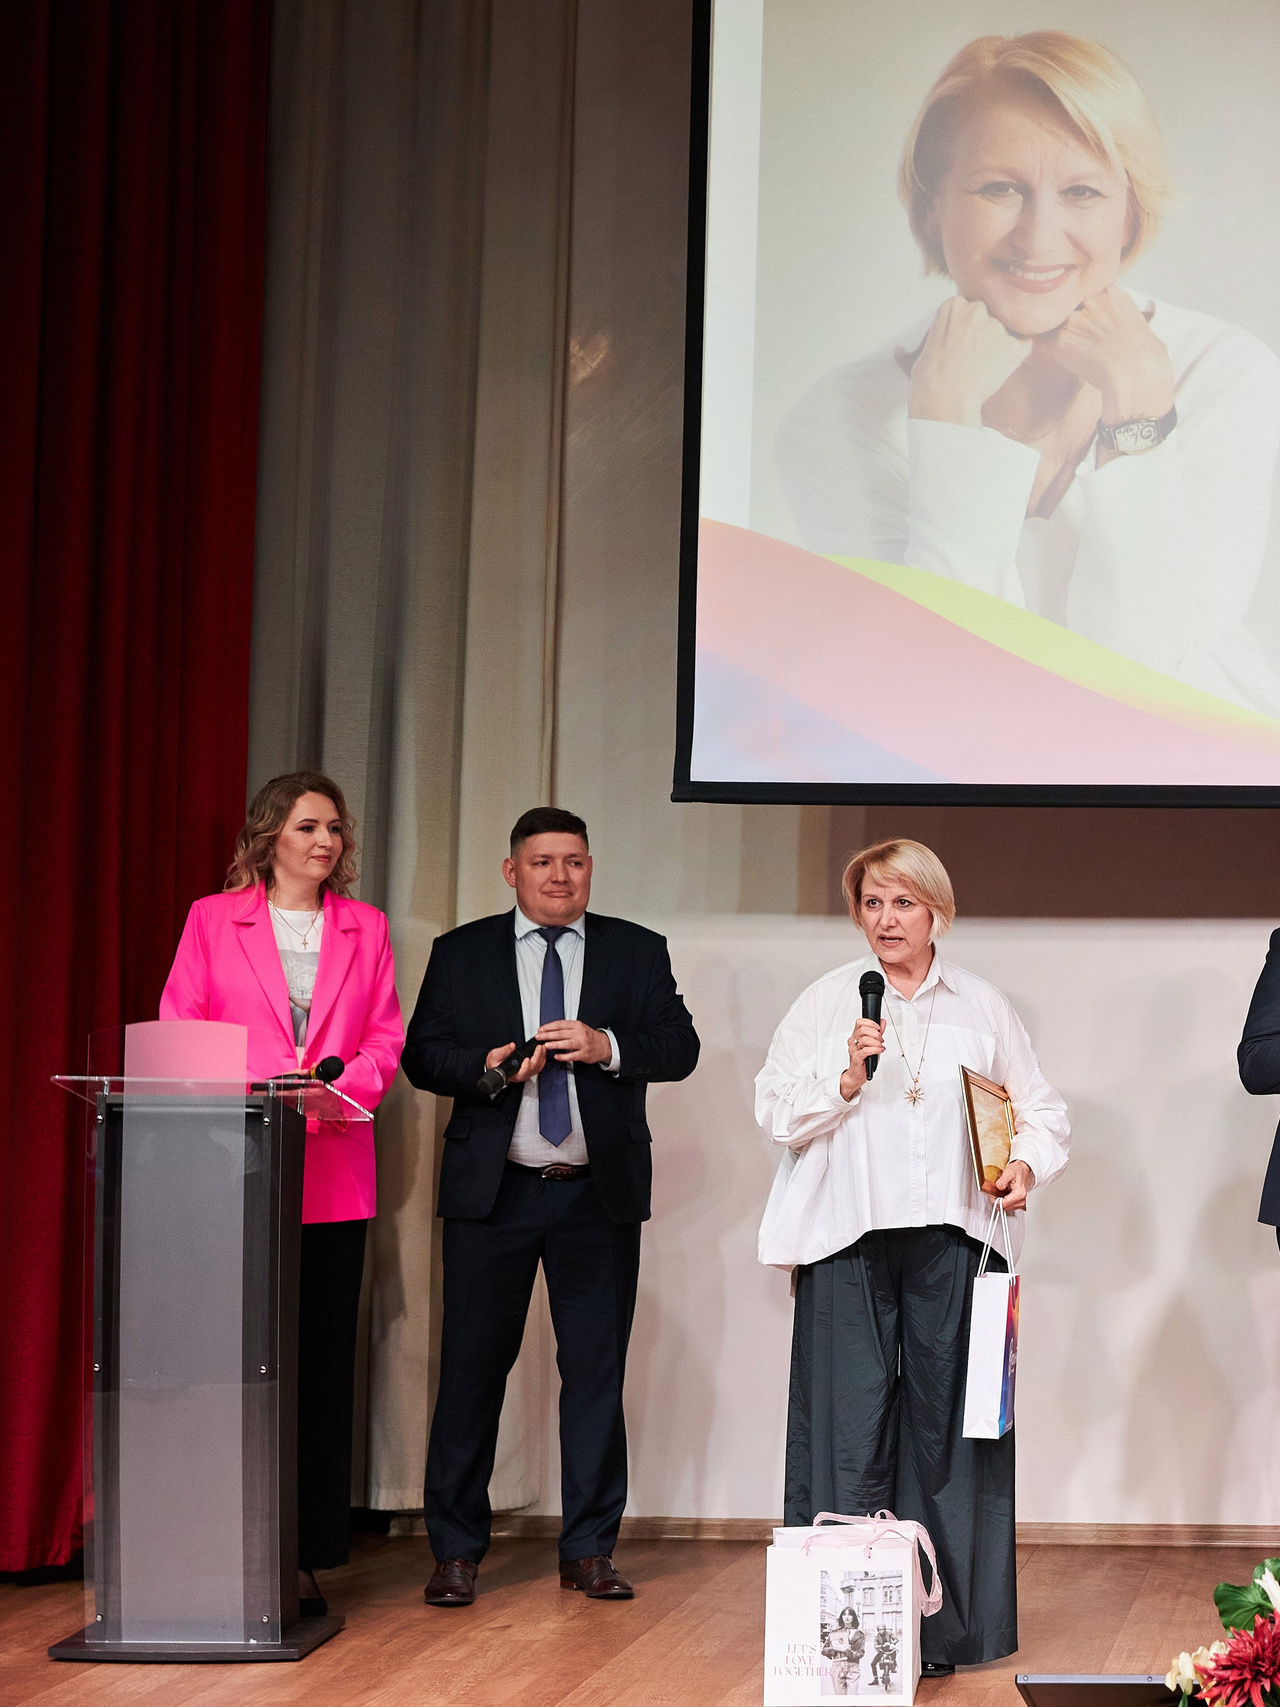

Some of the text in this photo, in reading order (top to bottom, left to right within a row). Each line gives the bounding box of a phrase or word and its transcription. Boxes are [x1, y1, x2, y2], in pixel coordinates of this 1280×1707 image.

[787, 1643, 817, 1654] LET'S
[785, 1655, 816, 1666] LOVE
[771, 1666, 833, 1677] TOGETHER
